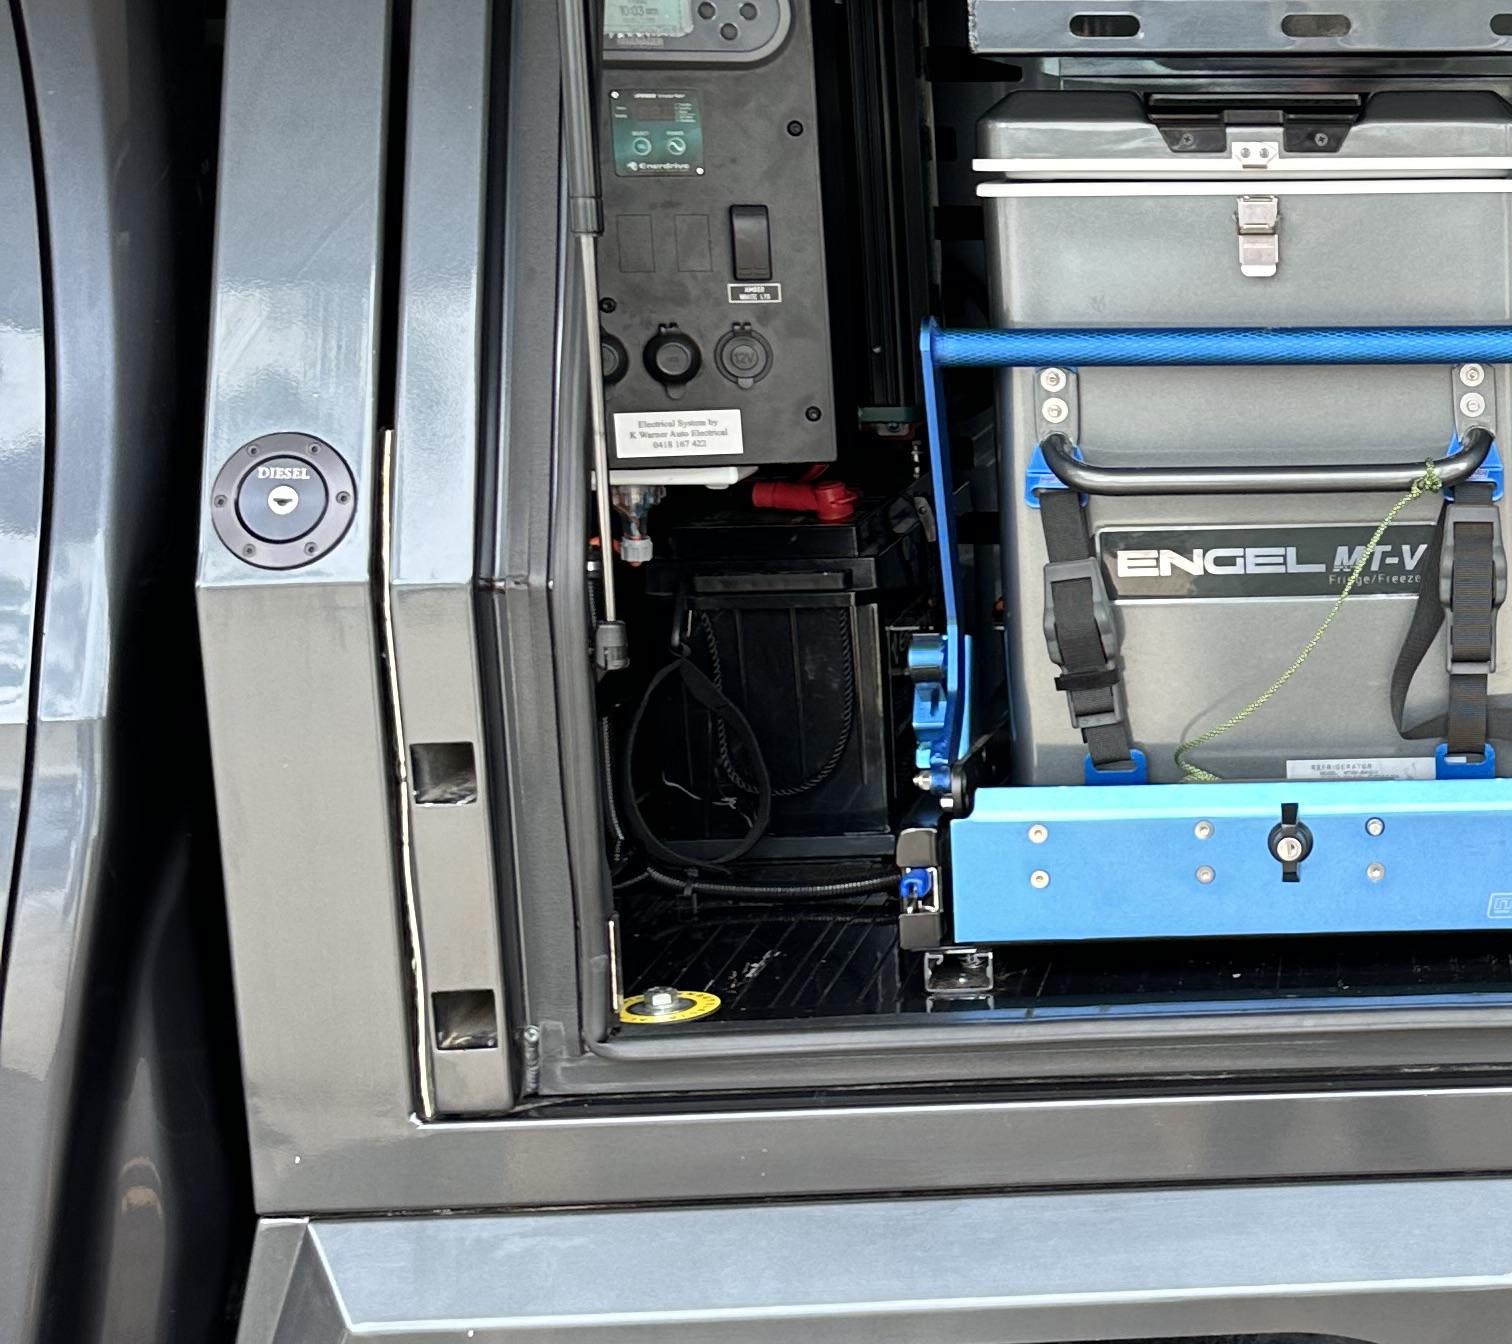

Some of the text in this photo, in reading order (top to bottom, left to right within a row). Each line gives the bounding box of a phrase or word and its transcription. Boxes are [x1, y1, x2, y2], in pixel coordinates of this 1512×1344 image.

[638, 418, 718, 429] Electrical System by
[669, 430, 689, 438] Auto
[691, 428, 728, 437] Electrical
[257, 466, 310, 480] DIESEL
[1116, 543, 1428, 578] ENGEL MT-V
[1328, 573, 1422, 587] Frige/Freeze
